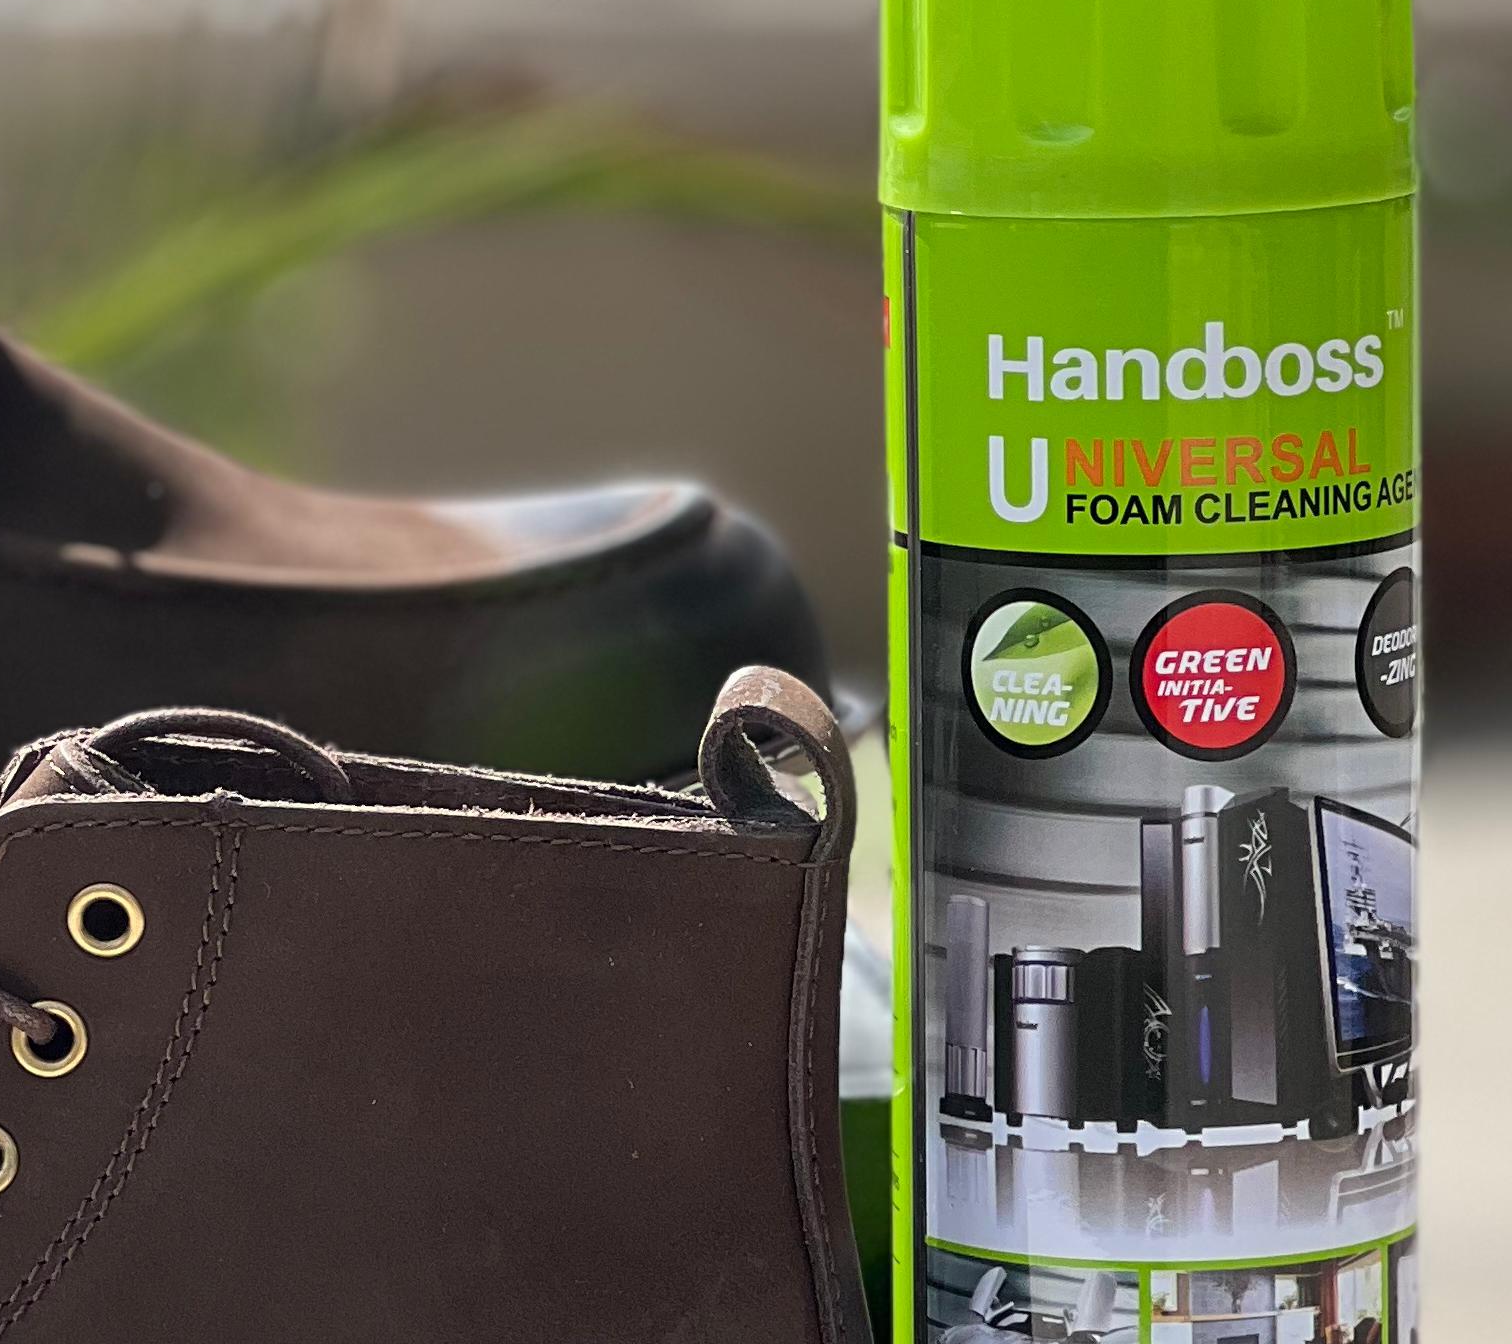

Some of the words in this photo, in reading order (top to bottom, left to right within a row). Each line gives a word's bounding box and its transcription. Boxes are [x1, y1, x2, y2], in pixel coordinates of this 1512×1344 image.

[988, 322, 1385, 402] Handboss
[1065, 493, 1183, 526] FOAM
[1194, 481, 1372, 523] CLEANING
[1376, 468, 1419, 508] AGE
[1154, 646, 1273, 676] GREEN
[992, 669, 1073, 696] CLEA-
[1157, 679, 1233, 697] INITIA-
[989, 698, 1071, 727] NING
[1180, 695, 1260, 724] TIVE
